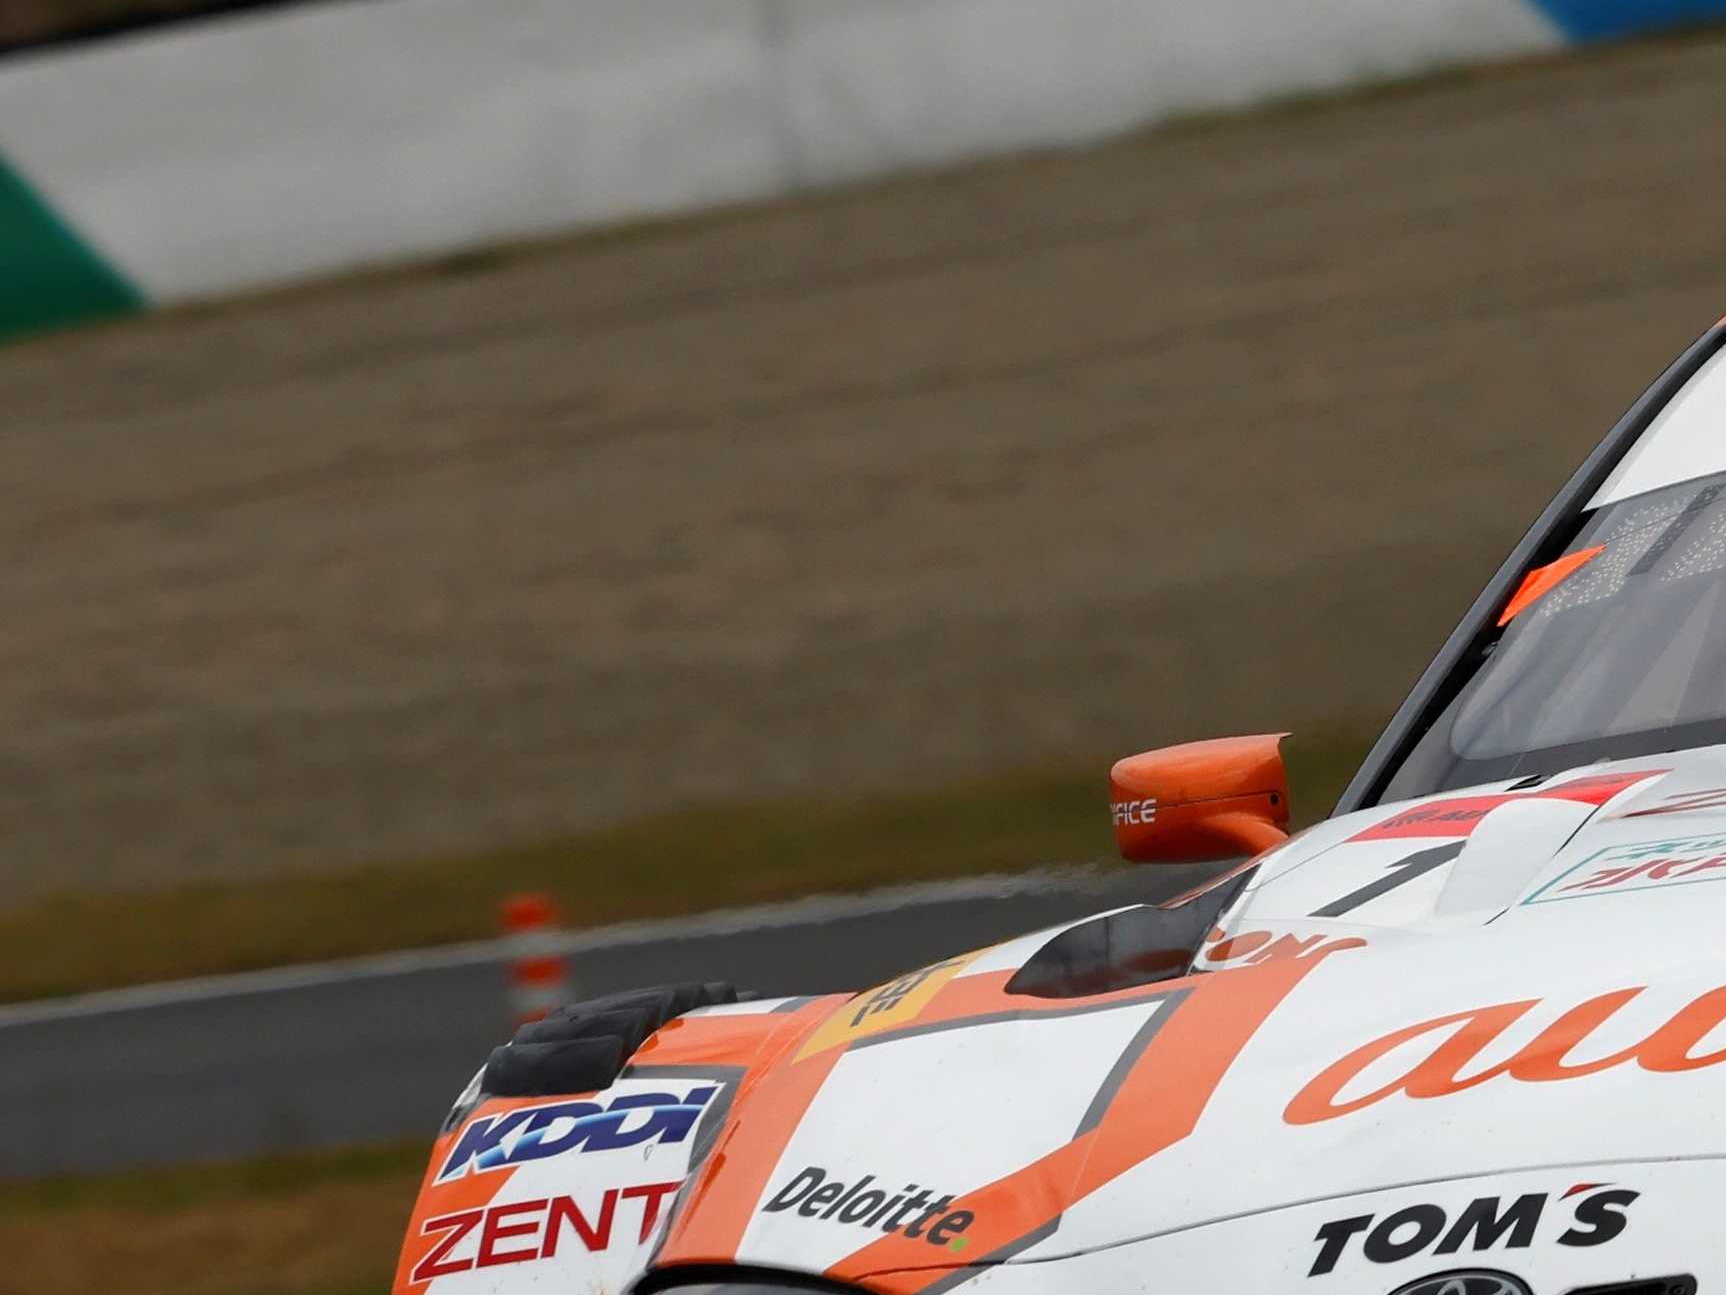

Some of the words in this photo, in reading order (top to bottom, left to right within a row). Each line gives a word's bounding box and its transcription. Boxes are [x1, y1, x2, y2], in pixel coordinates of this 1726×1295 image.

[440, 1080, 718, 1182] KDDI
[409, 1182, 685, 1284] ZENT
[1307, 1182, 1641, 1278] TOM'S
